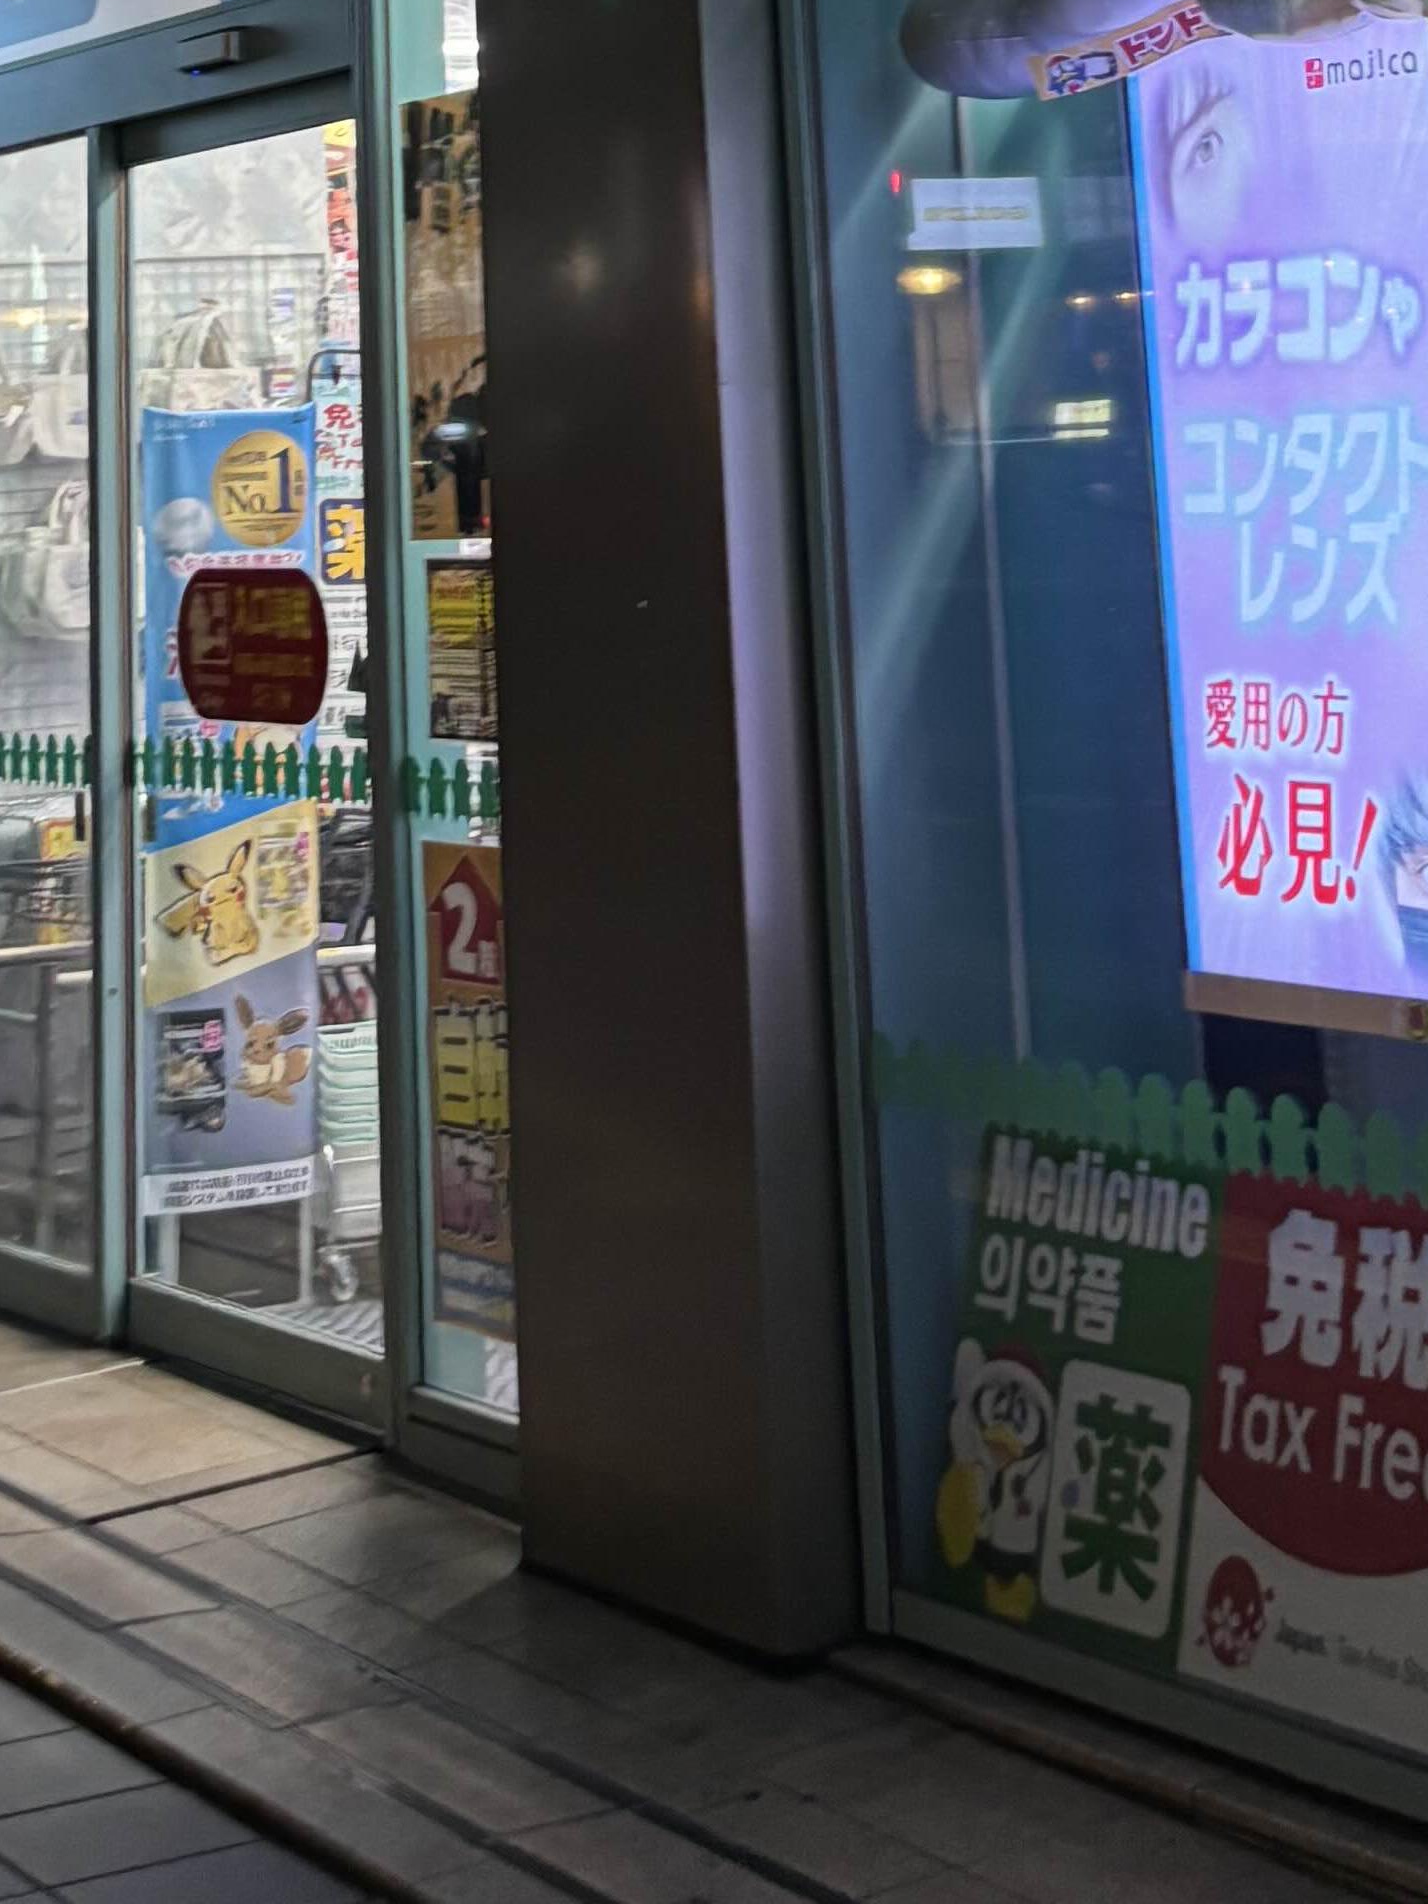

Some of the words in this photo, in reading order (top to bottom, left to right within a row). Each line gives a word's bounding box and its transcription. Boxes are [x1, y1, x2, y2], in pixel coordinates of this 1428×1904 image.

[1176, 254, 1420, 366] カラコンや
[1240, 513, 1400, 624] レンズ
[1206, 679, 1349, 755] 愛用の方
[985, 1135, 1214, 1258] Medicine
[976, 1232, 1123, 1347] 의약품
[1215, 1364, 1317, 1475] Tax
[1059, 1392, 1172, 1604] 薬
